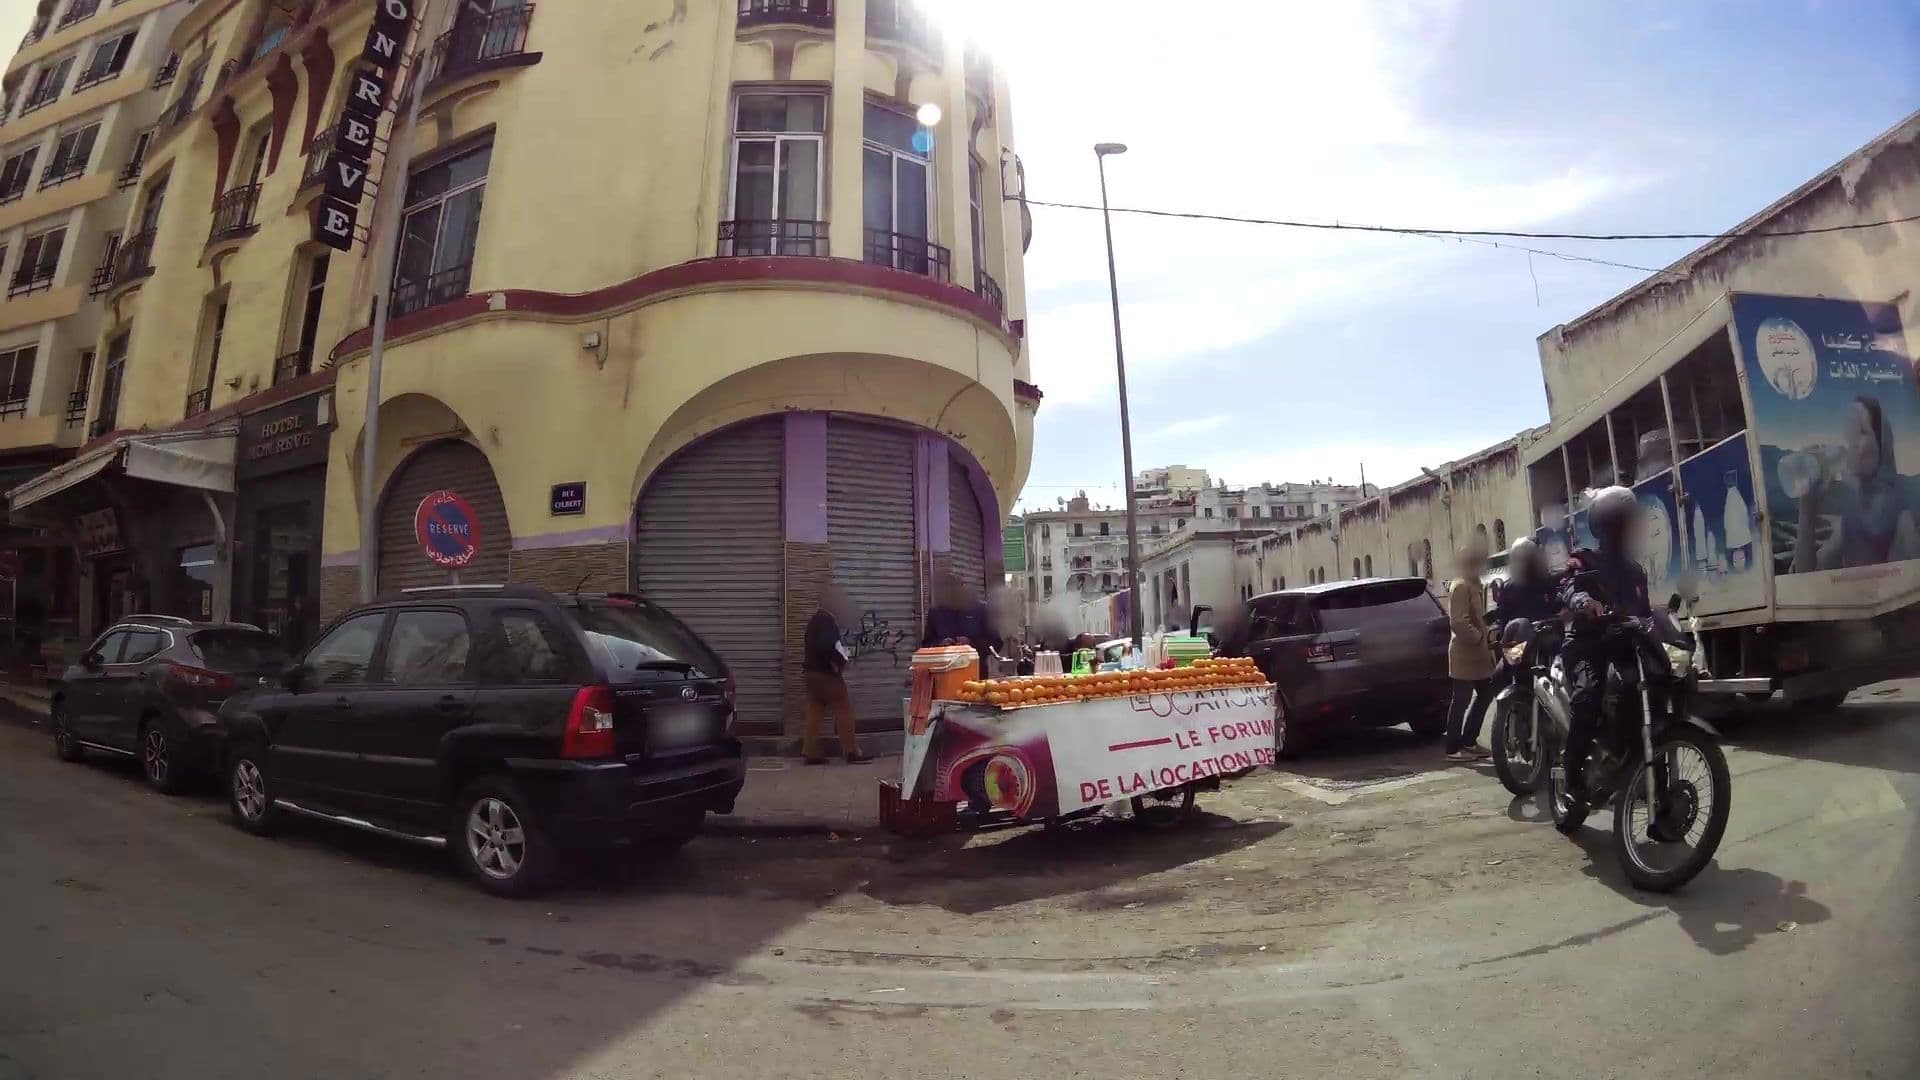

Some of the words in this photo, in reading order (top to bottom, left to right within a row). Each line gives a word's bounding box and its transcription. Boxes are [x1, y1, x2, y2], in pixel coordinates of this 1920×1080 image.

[262, 416, 303, 438] HOTEL
[429, 523, 469, 536] RESERVE
[1175, 730, 1202, 750] LE
[1208, 719, 1274, 743] FORUM
[1079, 779, 1112, 803] DE
[1117, 773, 1147, 795] LA
[1150, 750, 1252, 786] LOCATION
